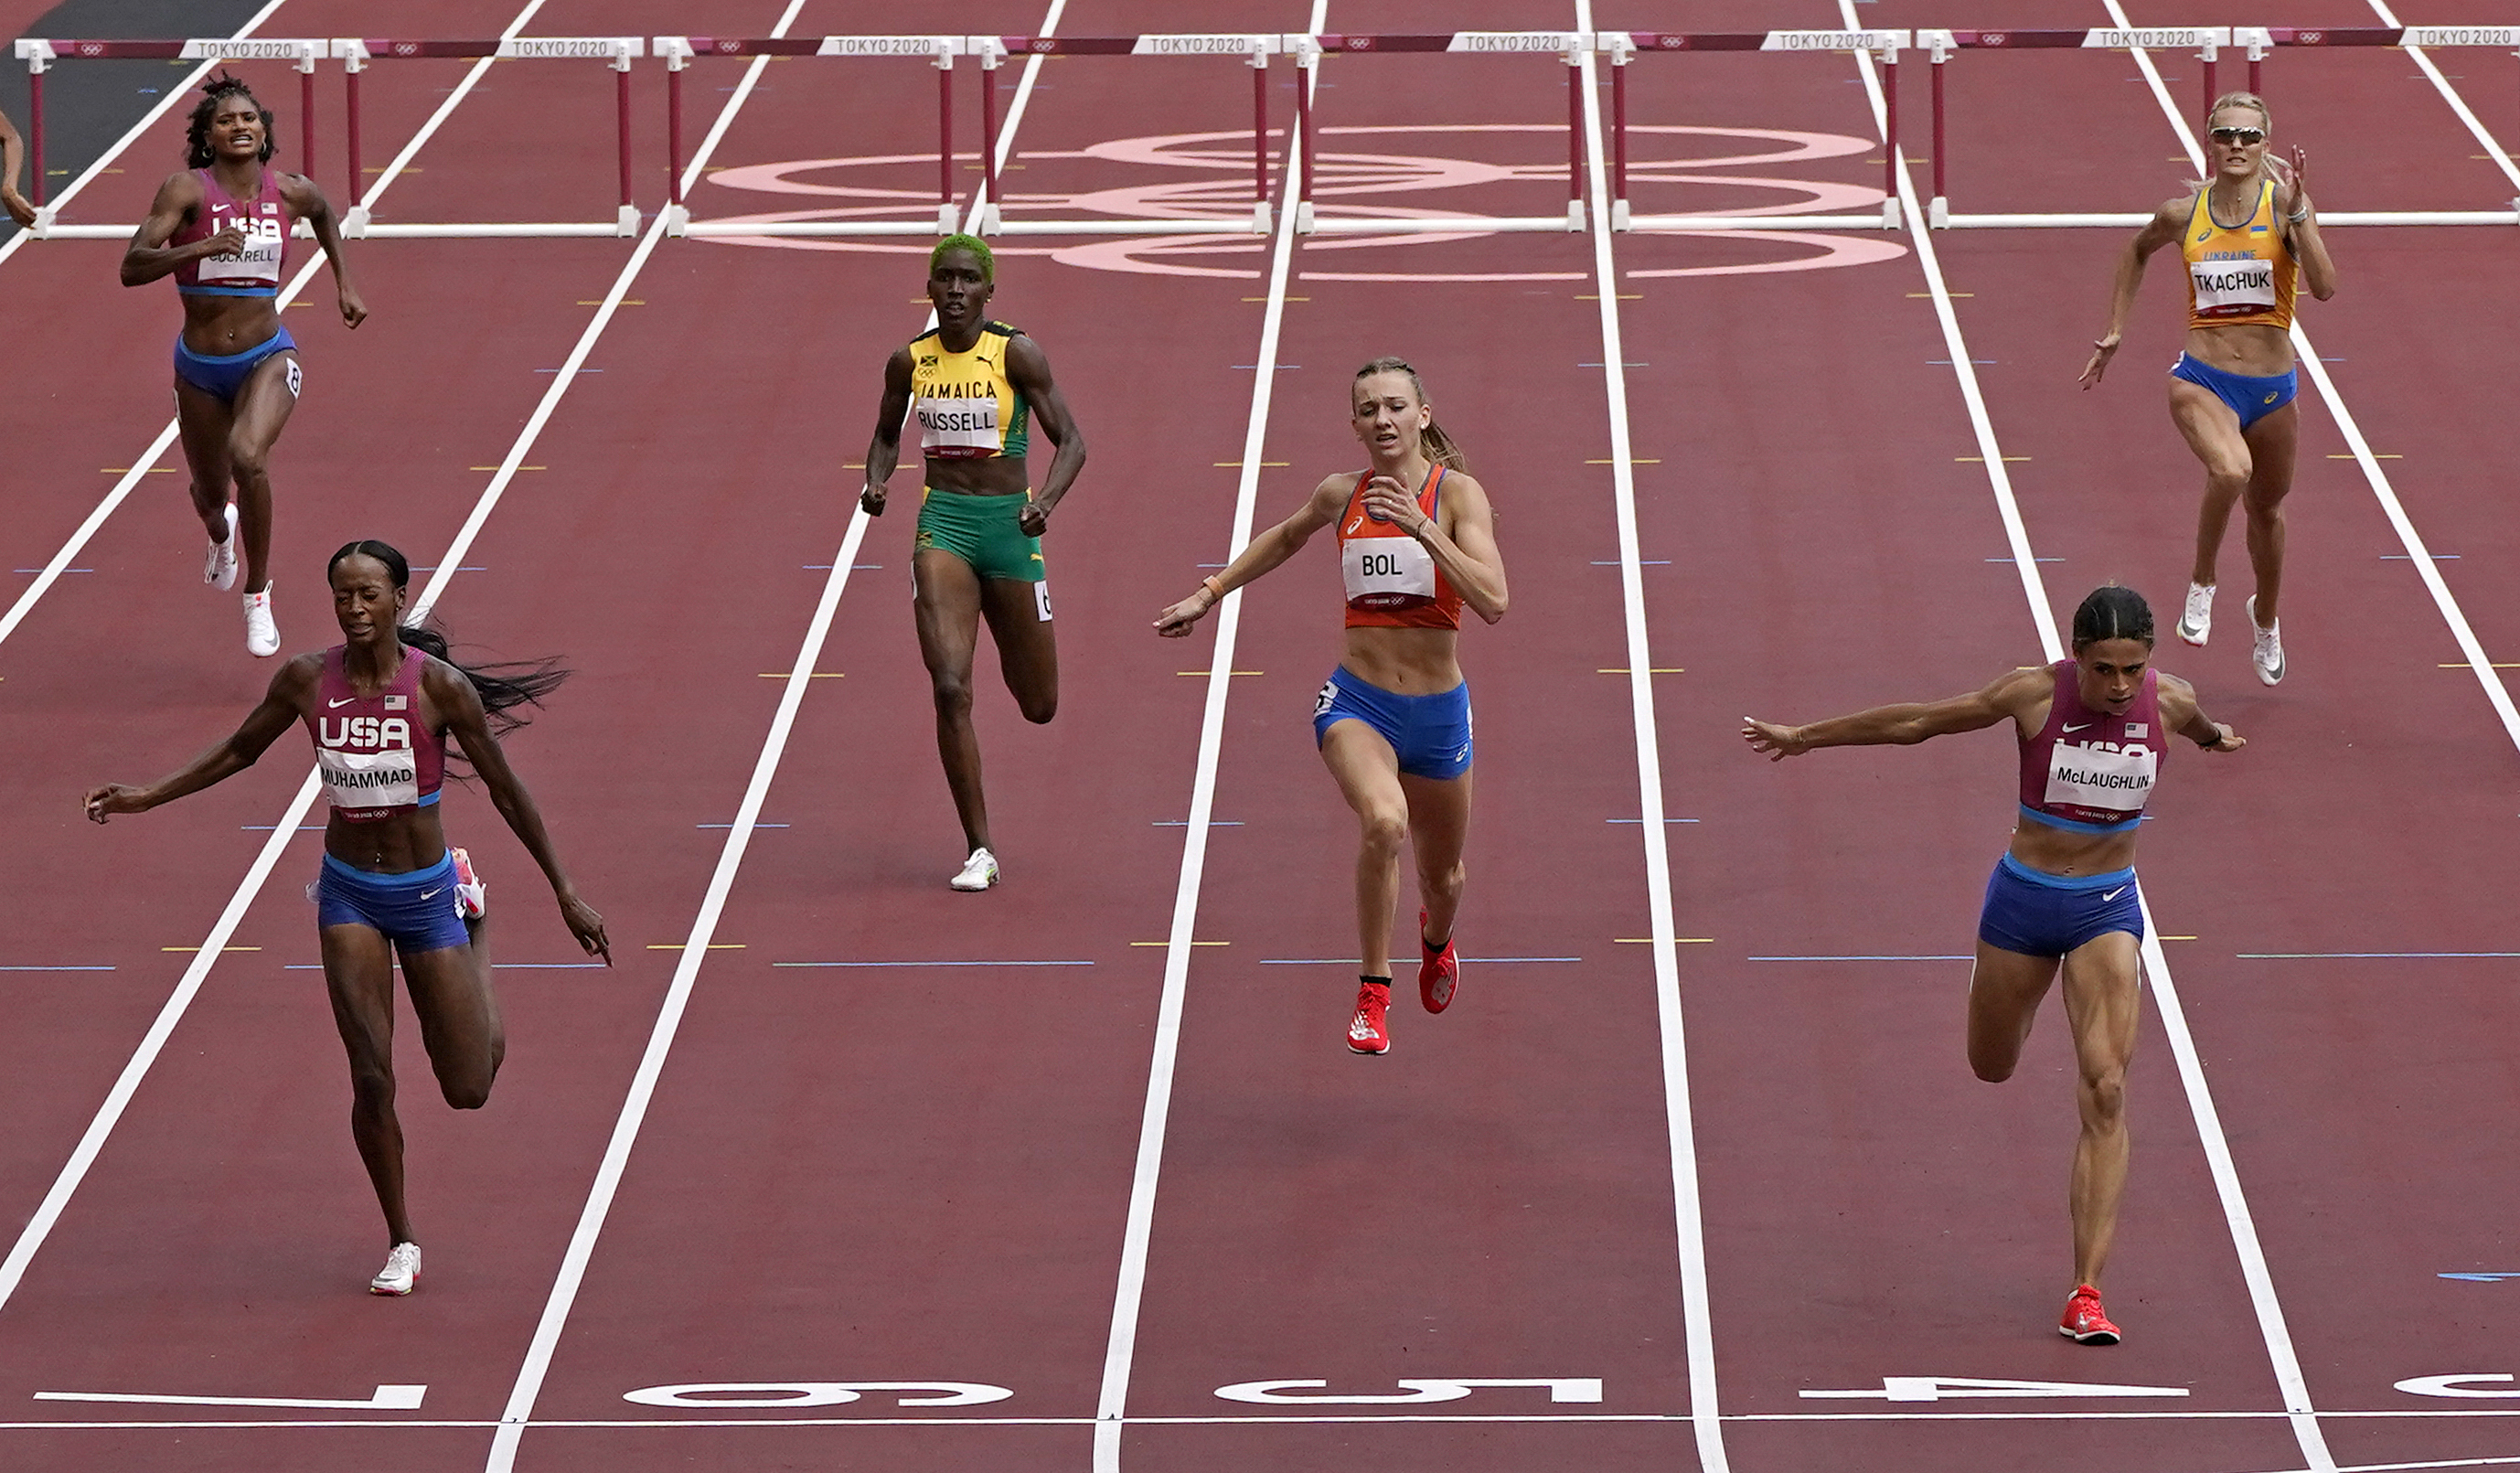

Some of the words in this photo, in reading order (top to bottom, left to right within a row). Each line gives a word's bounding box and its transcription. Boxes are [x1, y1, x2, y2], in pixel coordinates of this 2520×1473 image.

[836, 39, 888, 53] TOKYO
[892, 39, 931, 53] 2020
[1150, 37, 1202, 52] TOKYO
[1206, 37, 1244, 52] 2020
[1467, 36, 1518, 50] TOKYO
[1522, 36, 1560, 50] 2020
[1779, 34, 1831, 48] TOKYO
[1835, 34, 1874, 48] 2020
[2100, 31, 2152, 46] TOKYO
[2156, 31, 2194, 46] 2020
[2417, 30, 2469, 44] TOKYO
[2472, 30, 2511, 44] 2020
[198, 42, 250, 57] TOKYO
[254, 42, 292, 57] 2020
[513, 41, 565, 55] TOKYO
[569, 41, 607, 55] 2020
[2194, 272, 2270, 293] TKACHUK
[292, 368, 299, 392] 8
[918, 411, 995, 431] RUSSELL
[1362, 554, 1403, 576] BOL
[319, 716, 411, 749] USA
[321, 767, 412, 789] MUHAMMAD
[2057, 766, 2150, 789] McLAUGHLIN
[624, 1382, 1014, 1406] 6
[1213, 1379, 1602, 1404] 5
[1799, 1377, 2190, 1401] 4
